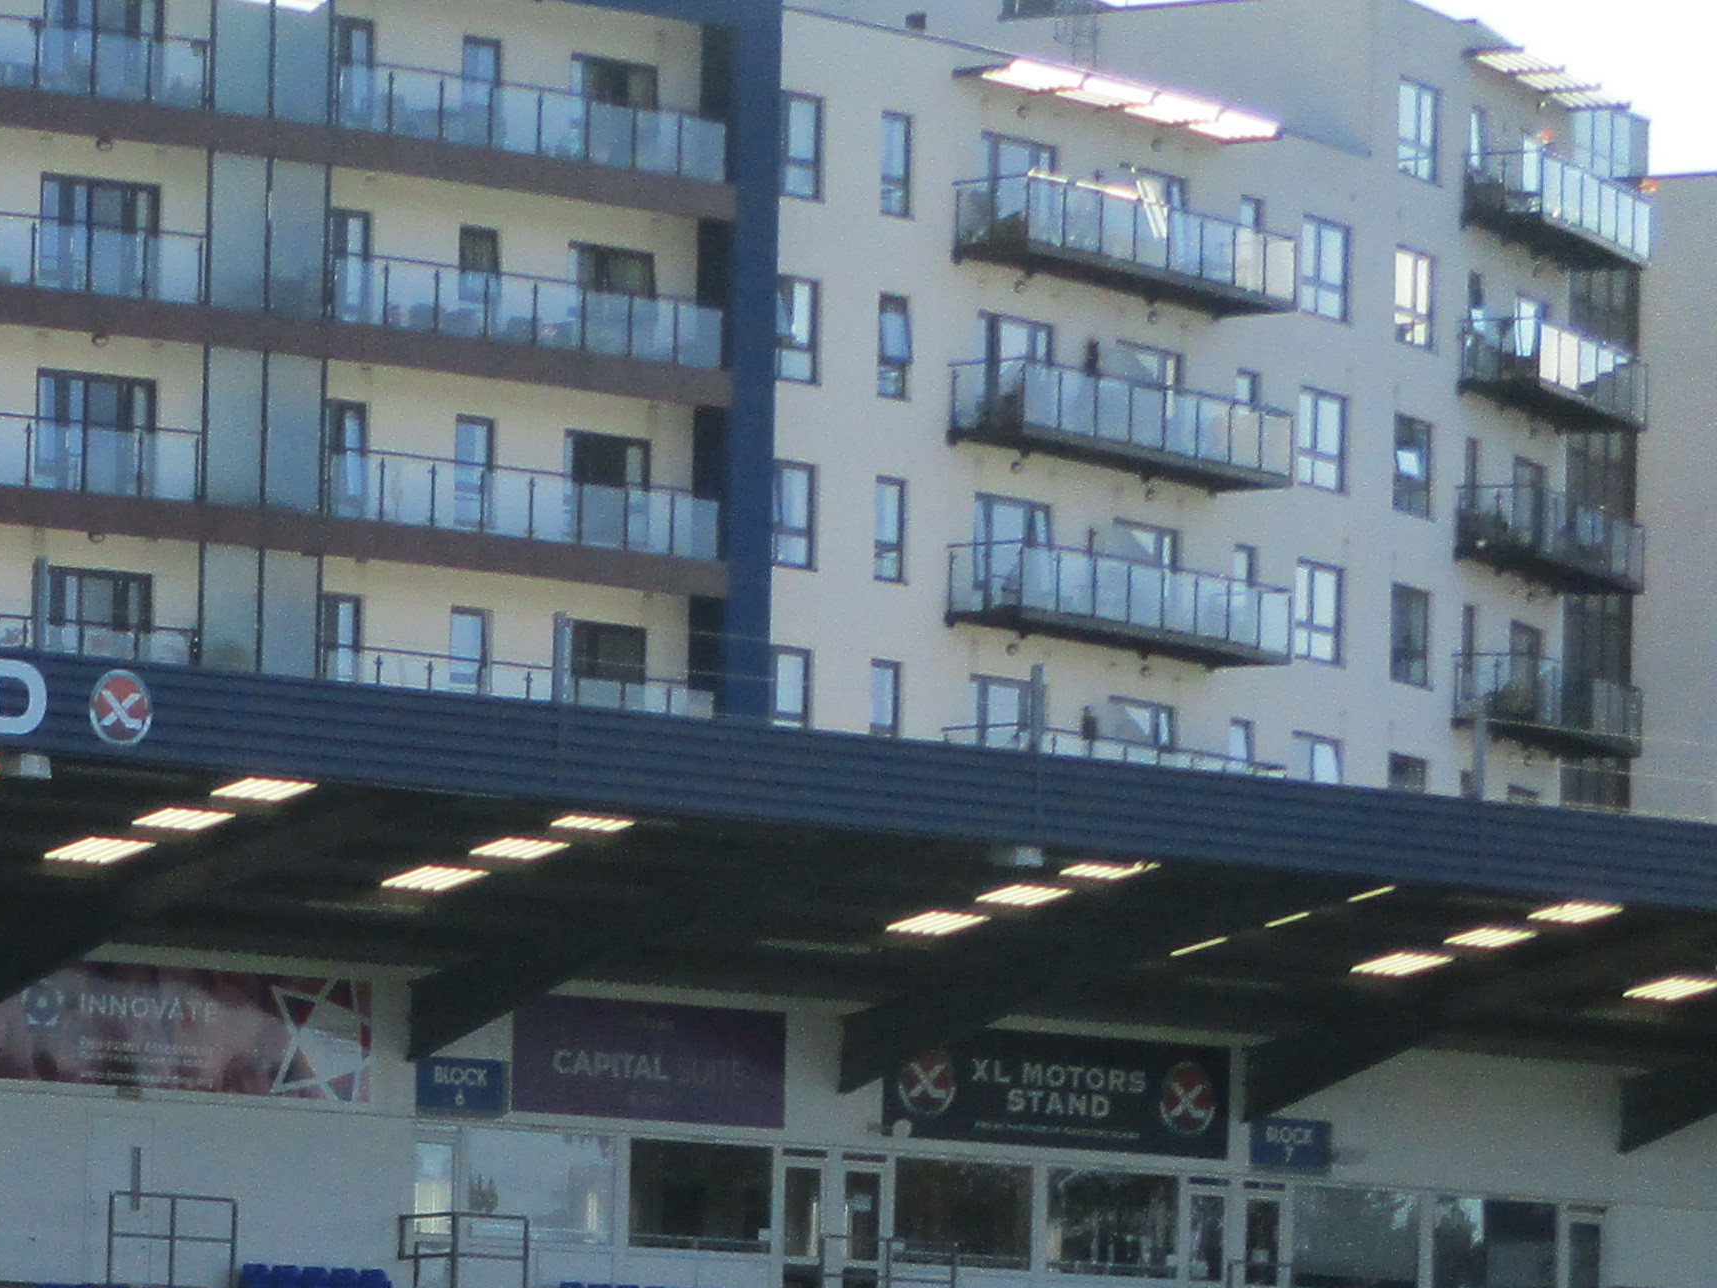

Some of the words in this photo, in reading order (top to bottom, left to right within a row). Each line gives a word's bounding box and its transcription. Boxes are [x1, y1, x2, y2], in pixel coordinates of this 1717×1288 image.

[80, 991, 219, 1024] INNOVATE
[434, 1065, 488, 1087] BLOCK
[553, 1049, 671, 1082] CAPITAL
[971, 1057, 1012, 1084] XL
[1022, 1062, 1147, 1094] MOTORS
[1007, 1088, 1111, 1118] STAND
[1266, 1126, 1314, 1145] BLOCK
